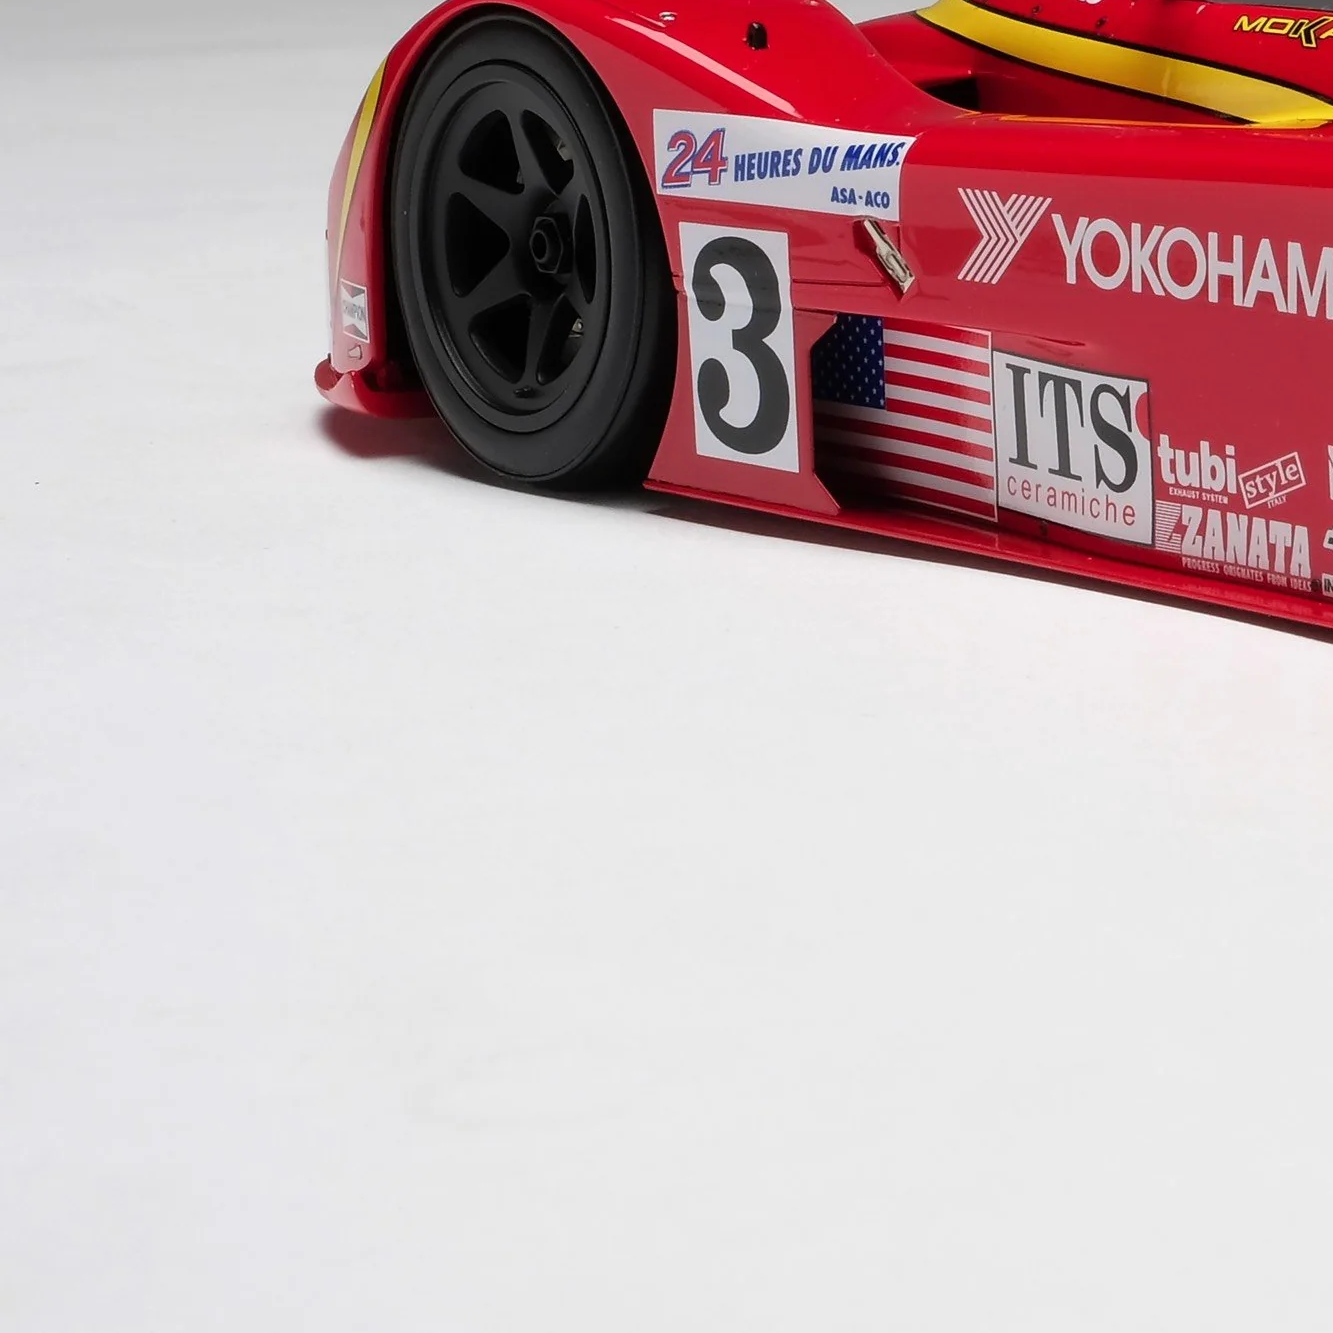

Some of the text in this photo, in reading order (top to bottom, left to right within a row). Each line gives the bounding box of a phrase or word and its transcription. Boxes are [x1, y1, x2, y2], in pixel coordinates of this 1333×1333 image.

[661, 128, 728, 188] 24
[734, 148, 803, 182] HEURES
[808, 146, 839, 175] DU
[692, 237, 790, 455] 3
[1005, 363, 1138, 493] ITS
[1157, 434, 1237, 494] tubi
[1246, 461, 1299, 499] style
[1007, 474, 1136, 526] ceramiche
[1267, 495, 1288, 509] ITALY
[1181, 504, 1312, 578] ZANATA
[1182, 557, 1220, 573] PROGRESS
